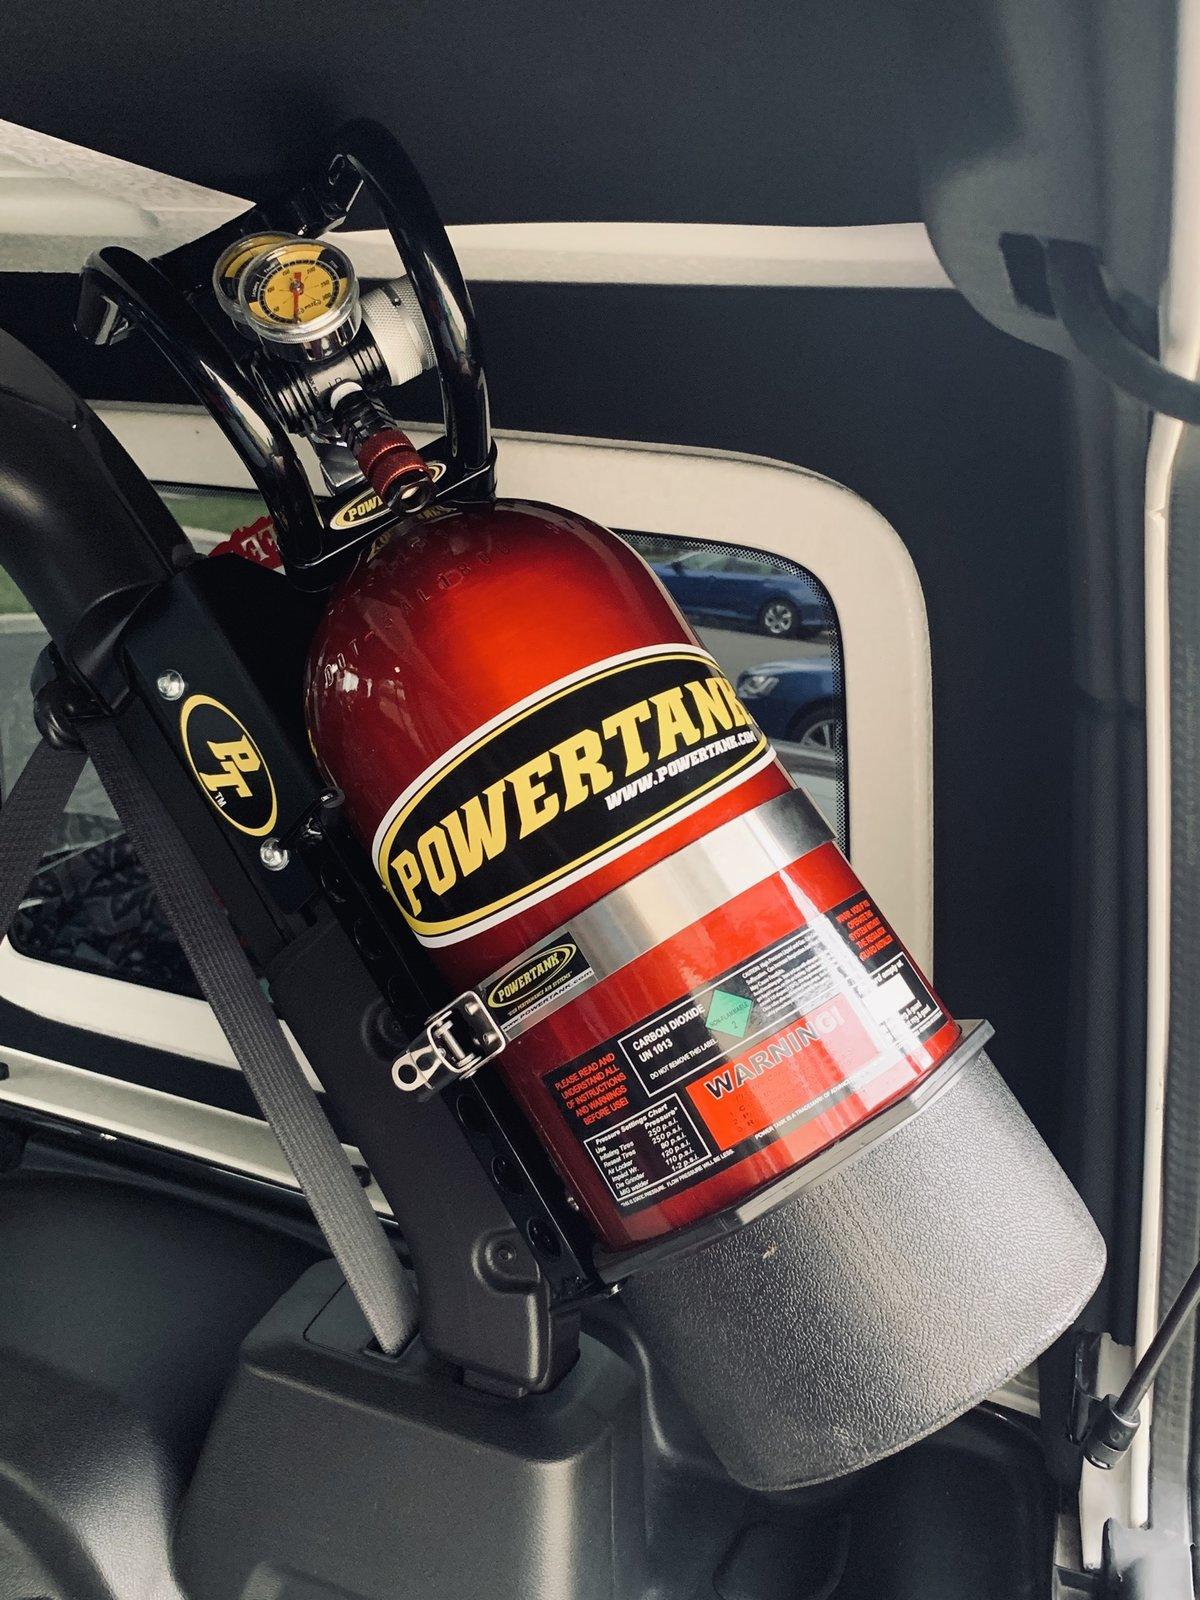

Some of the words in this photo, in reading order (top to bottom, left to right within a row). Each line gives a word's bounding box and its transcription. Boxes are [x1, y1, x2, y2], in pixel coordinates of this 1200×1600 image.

[199, 734, 260, 798] PT
[605, 727, 756, 809] WWW.POWERTANK.COM
[394, 676, 750, 913] POWERTANK
[498, 953, 559, 1001] POWERTANK
[502, 969, 593, 1030] www.POWERTANK.com
[633, 1024, 670, 1050] CARBON
[668, 1001, 705, 1030] DIOXIDE
[731, 1020, 738, 1029] 2
[639, 1049, 653, 1062] UN
[653, 1038, 673, 1054] 1013
[650, 1071, 659, 1080] DO
[658, 1065, 669, 1075] NOT
[668, 1053, 690, 1069] REMOVE
[688, 1047, 701, 1057] THIS
[705, 1004, 845, 1100] WARNING!
[555, 1073, 579, 1089] PLEASE
[578, 1062, 598, 1078] READ
[599, 1053, 615, 1067] AND
[562, 1072, 605, 1099] UNDERSTAND
[605, 1064, 620, 1076] ALL
[566, 1099, 575, 1109] OF
[575, 1072, 626, 1104] INSTRUCTIONS
[576, 1105, 589, 1117] AND
[588, 1085, 627, 1109] WARNINGS
[584, 1106, 611, 1125] BEFORE
[595, 1127, 621, 1145] Pressure
[621, 1116, 647, 1132] Settings
[648, 1103, 668, 1118] Chart
[595, 1146, 606, 1154] Use
[619, 1141, 634, 1151] Tires
[648, 1126, 661, 1137] 250
[621, 1149, 636, 1159] Tires
[652, 1133, 665, 1144] 250
[612, 1170, 629, 1182] Impact
[661, 1148, 673, 1158] 120
[615, 1160, 633, 1172] Locker
[661, 1140, 669, 1149] 80
[625, 1172, 644, 1185] Grinder
[665, 1155, 677, 1165] 110
[620, 1187, 631, 1196] MIG
[631, 1179, 649, 1191] welder
[672, 1162, 682, 1171] 1-2
